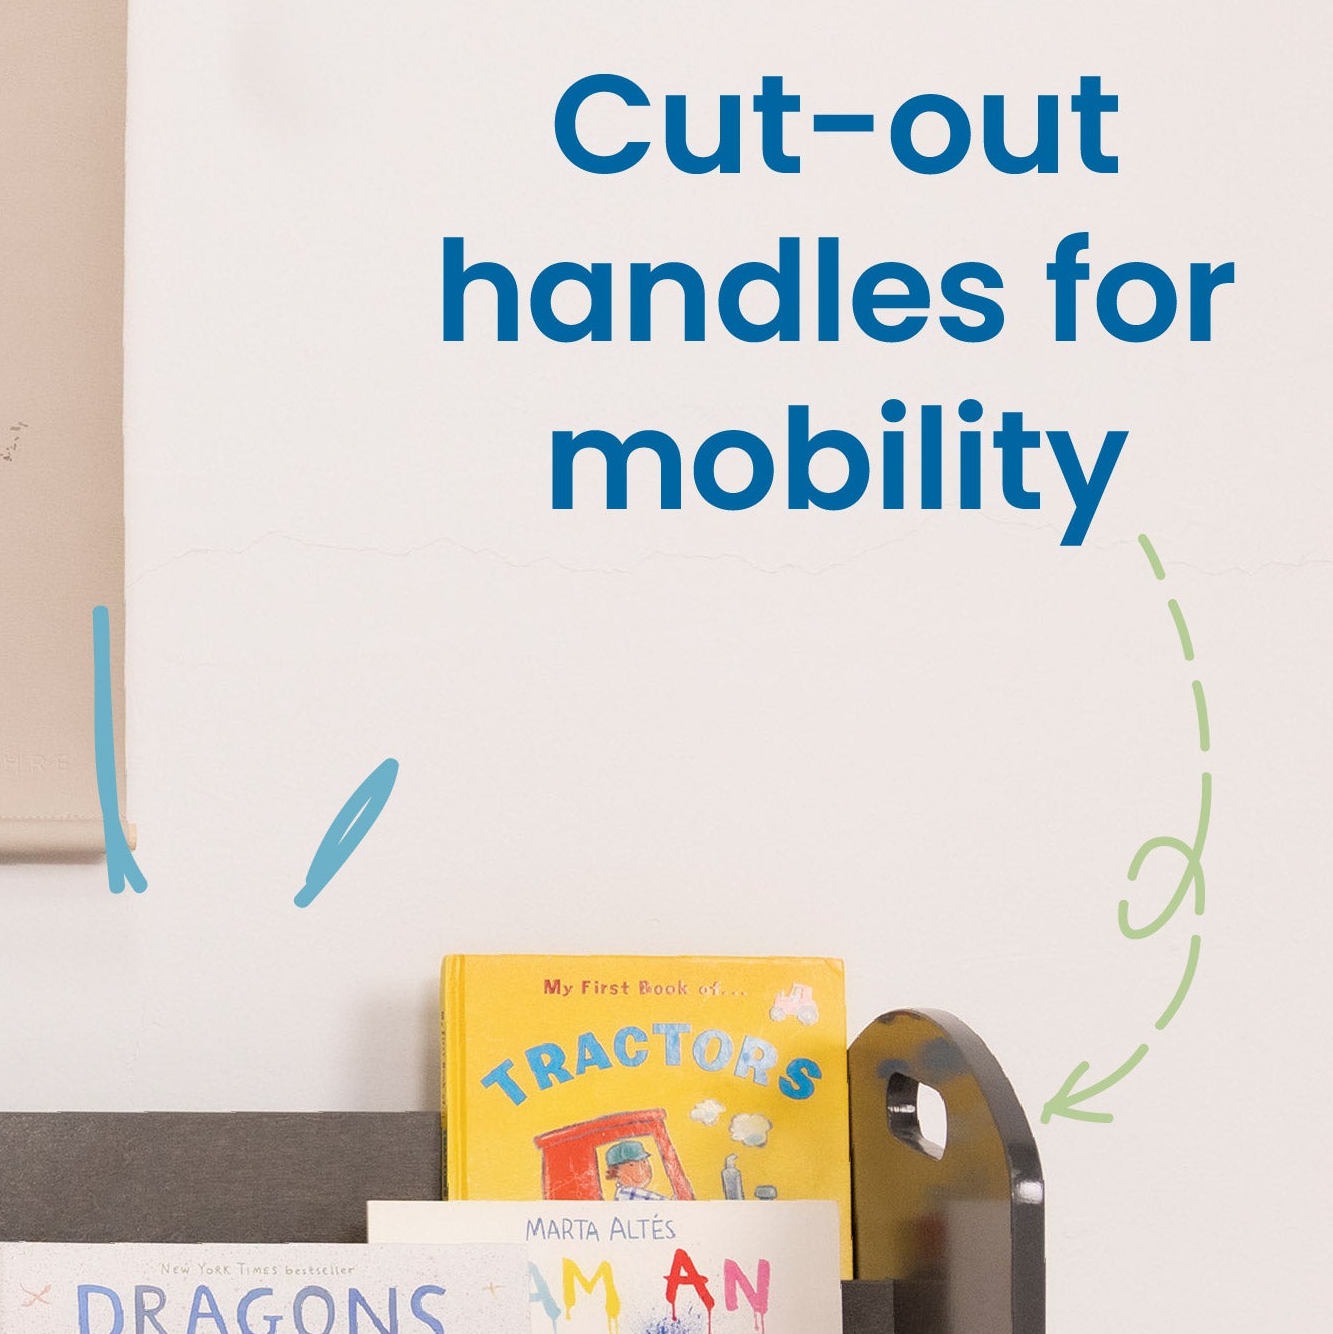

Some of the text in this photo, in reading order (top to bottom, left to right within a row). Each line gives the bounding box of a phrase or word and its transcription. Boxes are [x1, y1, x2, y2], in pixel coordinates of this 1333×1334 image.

[543, 978, 574, 999] My
[581, 979, 629, 996] First
[638, 979, 688, 996] Book
[480, 1022, 823, 1108] TRACTORS
[526, 1213, 676, 1242] MARTA ALTÉS
[285, 1264, 358, 1277] bestseller
[663, 1248, 771, 1332] AN
